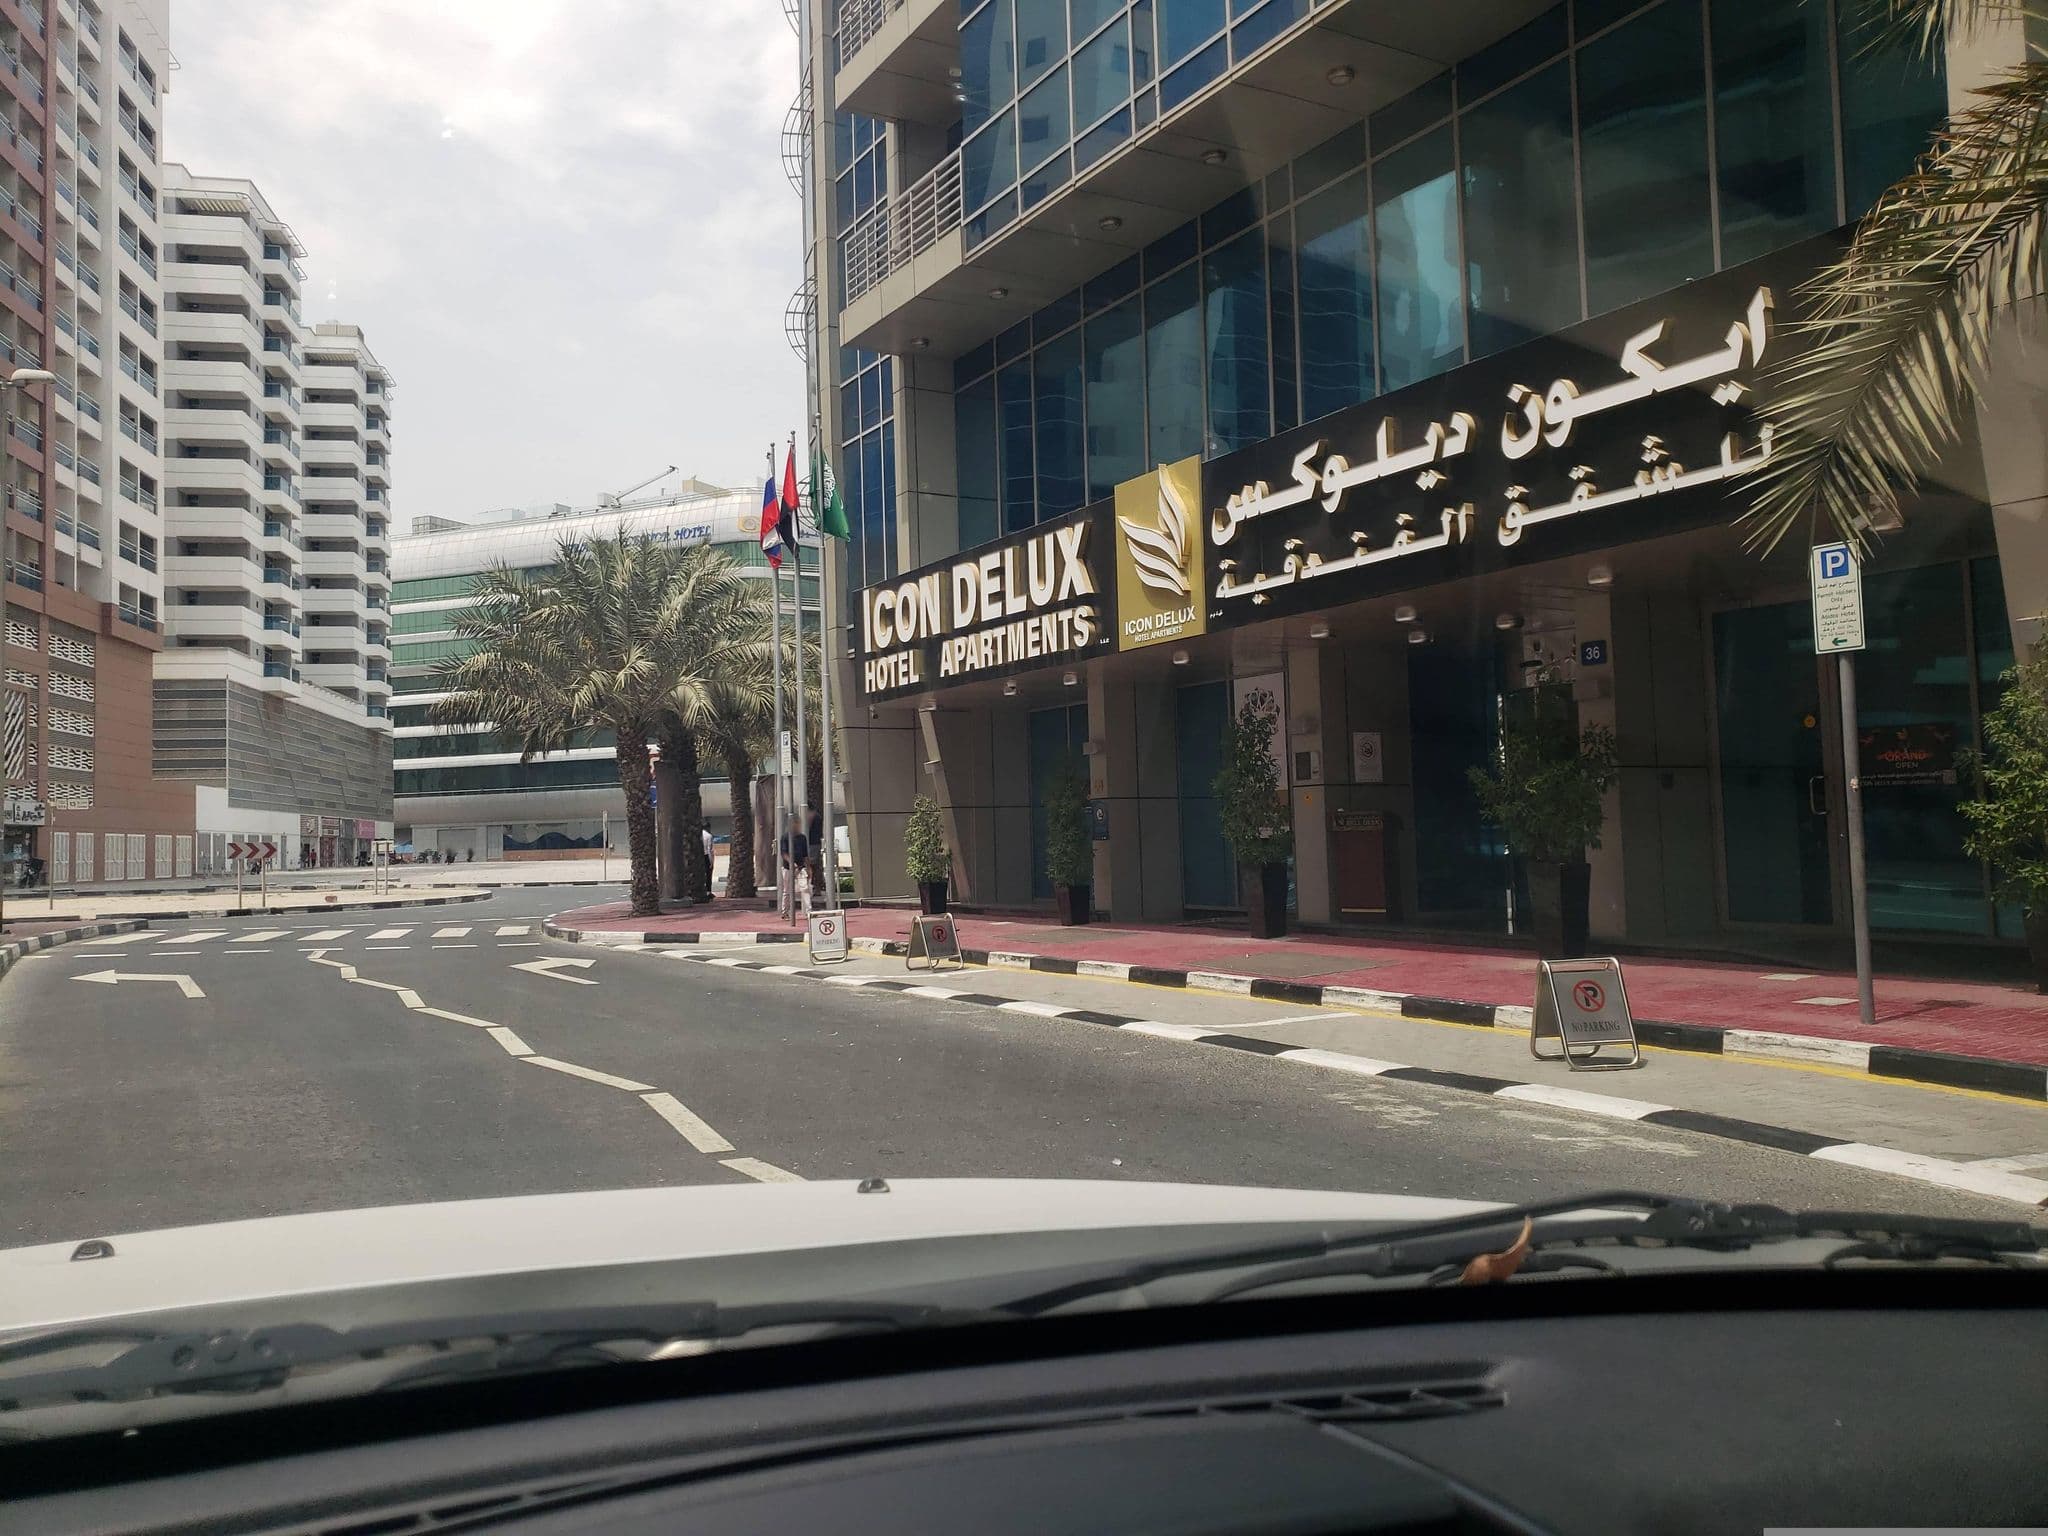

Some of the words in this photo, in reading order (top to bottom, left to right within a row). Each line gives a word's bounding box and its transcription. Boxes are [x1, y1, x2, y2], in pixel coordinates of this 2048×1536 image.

[1502, 286, 1773, 459] ايكون
[1211, 411, 1476, 546] ديلوكس
[673, 525, 711, 540] HOTEL
[1215, 502, 1474, 605] الفندقية
[863, 572, 945, 653] ICON
[952, 520, 1096, 630] DELUX
[865, 649, 920, 693] HOTEL
[939, 604, 1096, 678] APARTMENTS
[1125, 615, 1153, 636] ICON
[1155, 605, 1197, 629] DELUX
[1134, 631, 1151, 643] HOTEL
[1151, 624, 1183, 640] APARTMENTS
[1585, 646, 1600, 660] 36
[1584, 1020, 1620, 1032] PARKING
